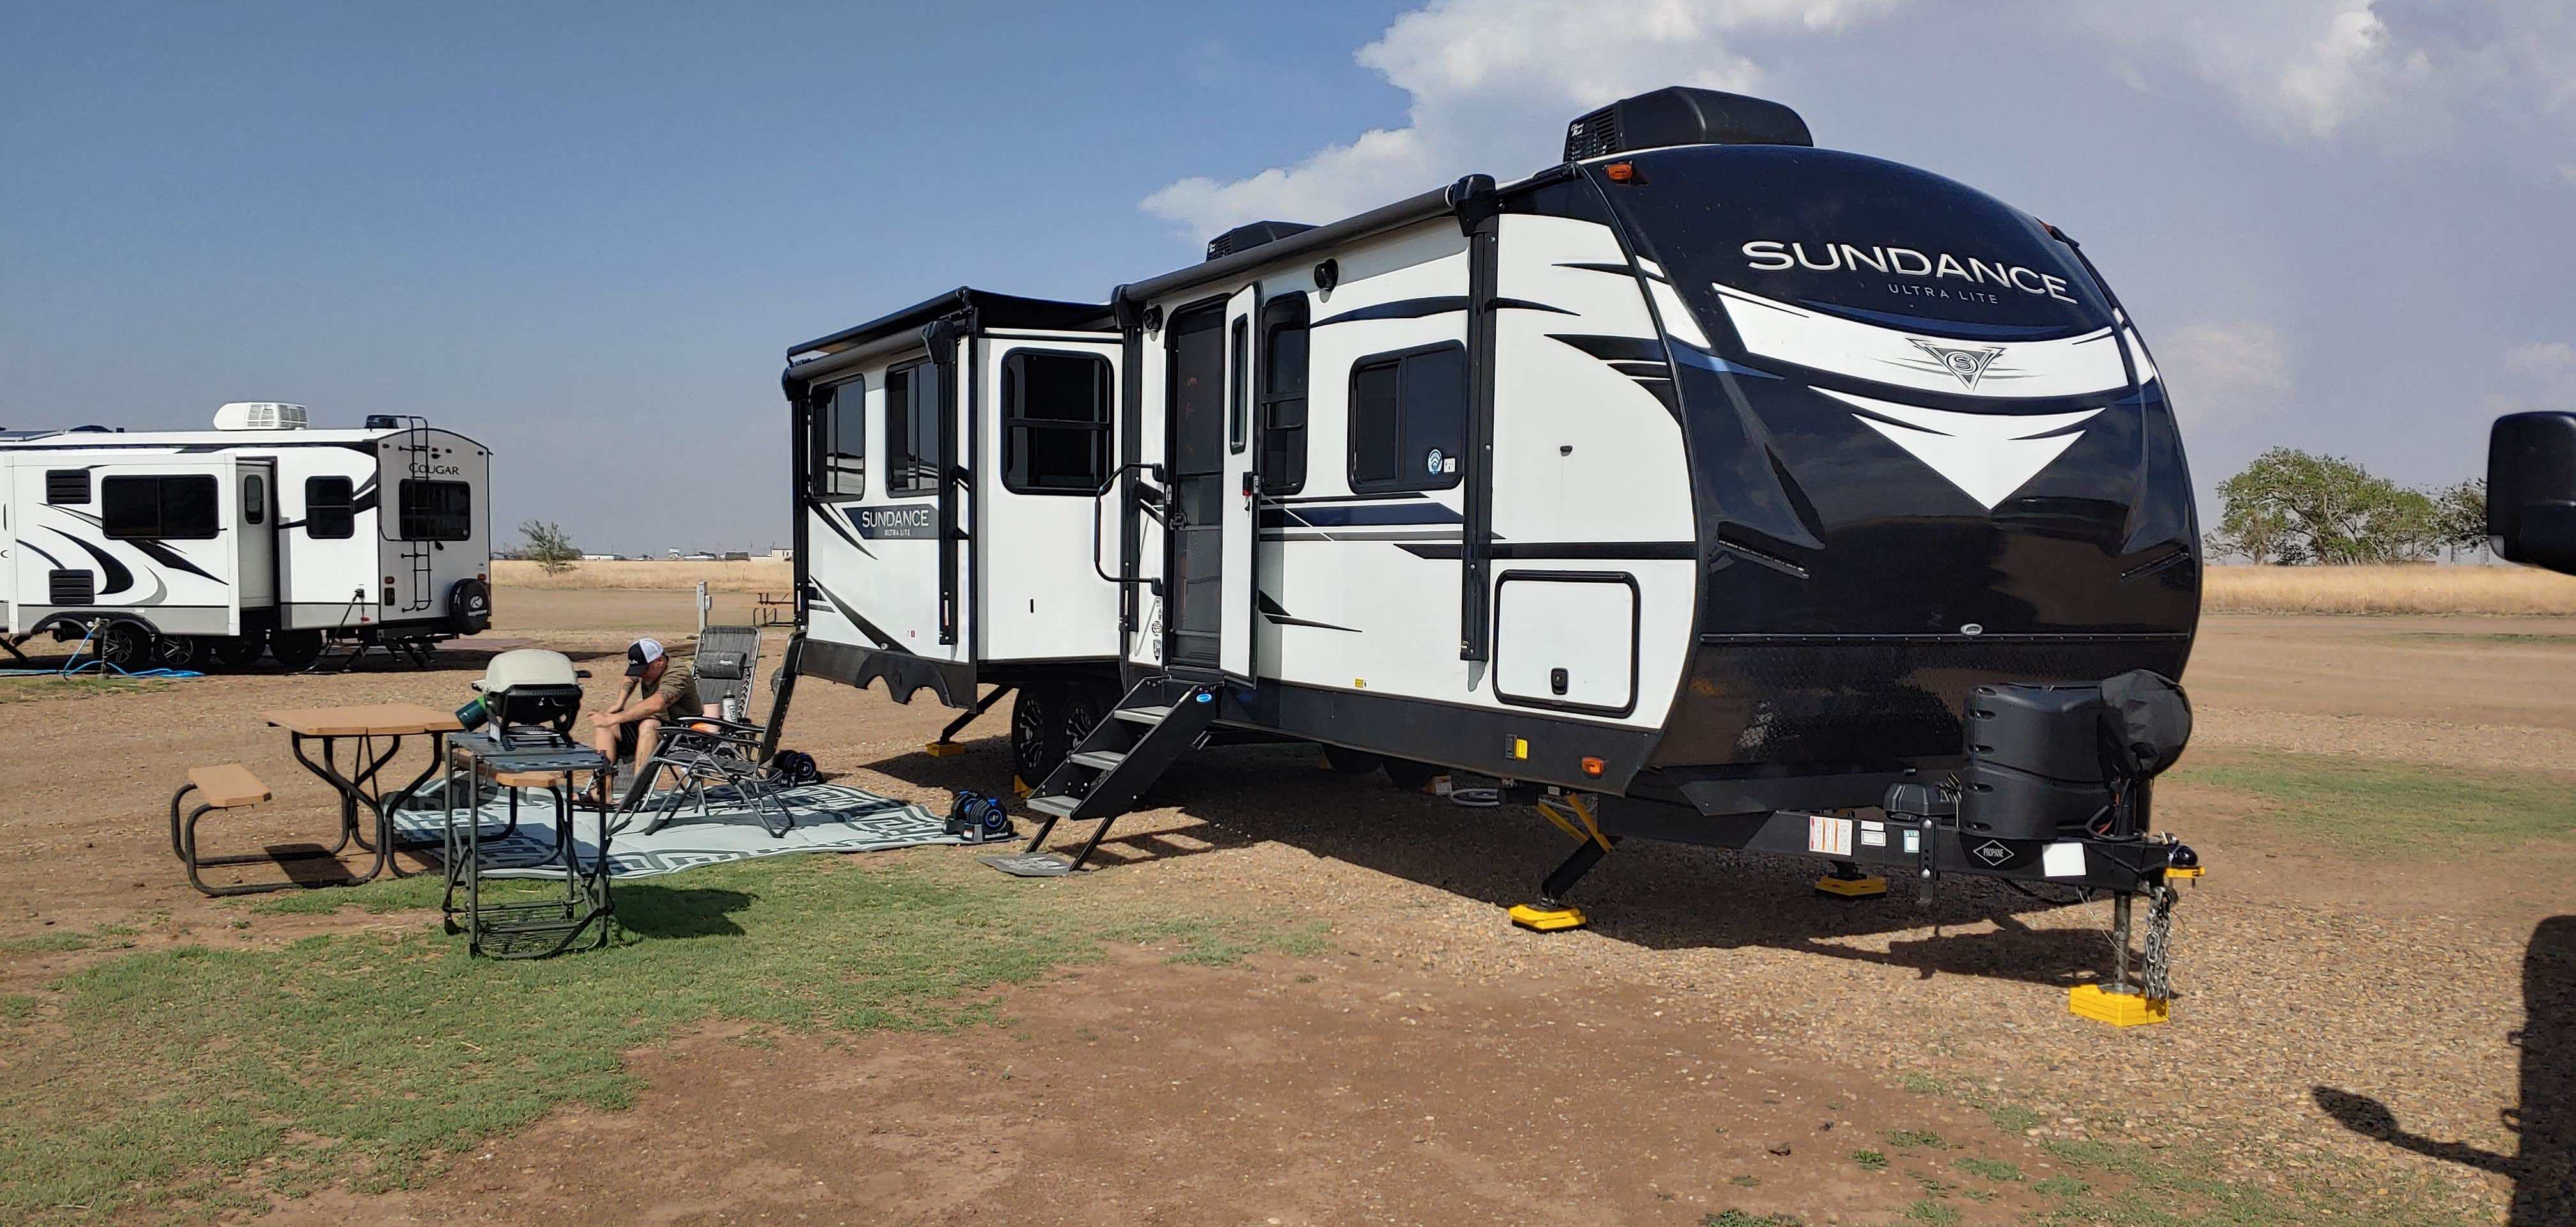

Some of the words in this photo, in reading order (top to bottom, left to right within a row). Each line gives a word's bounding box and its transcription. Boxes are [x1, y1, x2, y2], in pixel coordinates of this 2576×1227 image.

[1741, 240, 2078, 305] SUNDANCE
[1888, 283, 1950, 299] ULTRA
[1958, 290, 1998, 304] LITE
[409, 463, 459, 475] COUGAR
[861, 509, 930, 528] SUNDANCE
[884, 529, 900, 537] ULTRA
[1983, 847, 2004, 858] PROPANE
